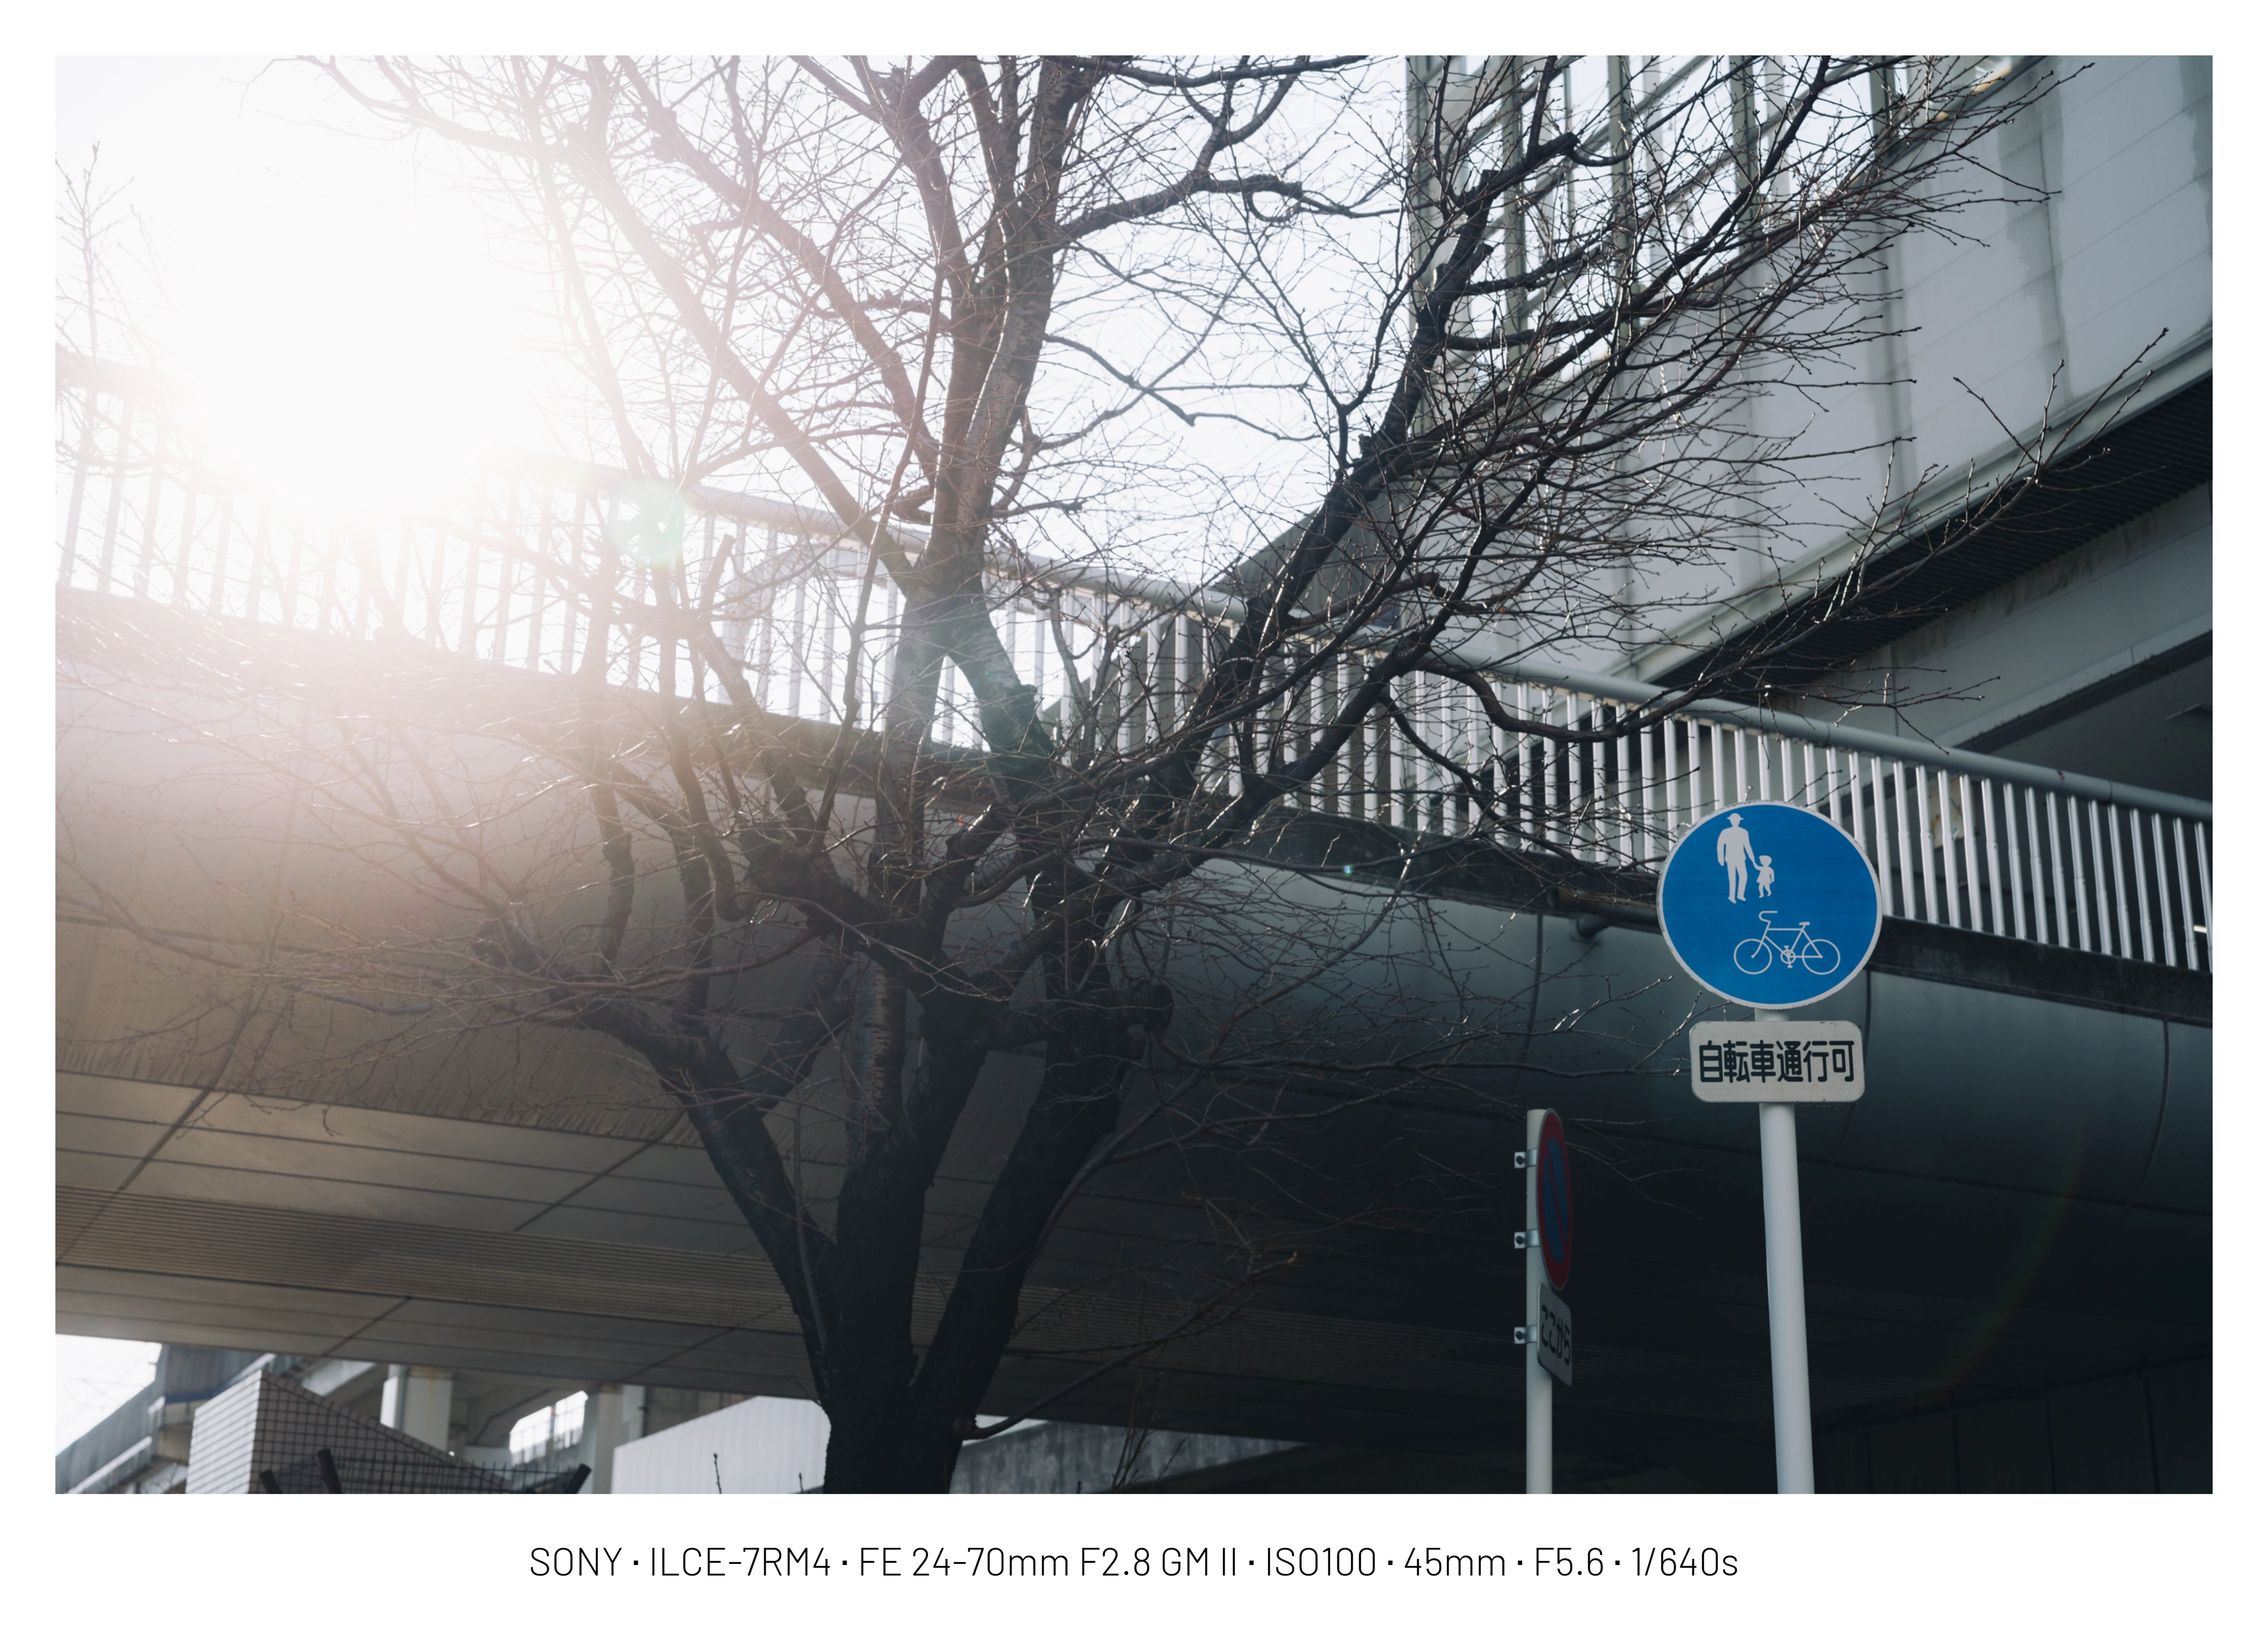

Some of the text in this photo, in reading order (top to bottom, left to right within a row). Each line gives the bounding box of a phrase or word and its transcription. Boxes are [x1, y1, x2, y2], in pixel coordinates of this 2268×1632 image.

[1699, 1039, 1855, 1083] 自転車通行可
[1541, 1304, 1571, 1366] ここから
